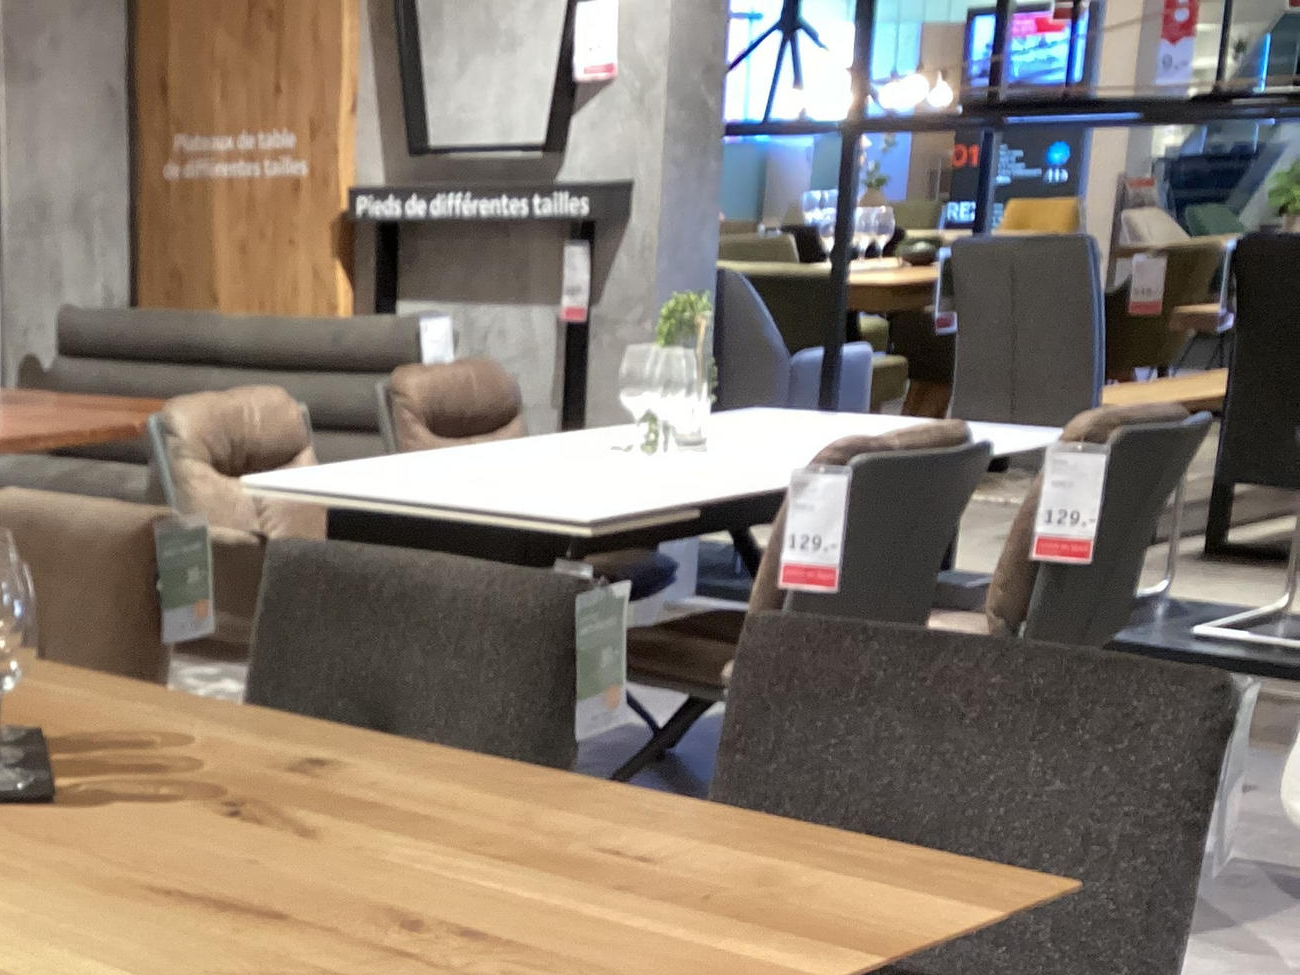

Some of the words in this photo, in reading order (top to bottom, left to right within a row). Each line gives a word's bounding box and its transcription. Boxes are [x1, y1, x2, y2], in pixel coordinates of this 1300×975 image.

[236, 129, 255, 150] de
[257, 127, 298, 150] table
[162, 160, 180, 180] de
[263, 155, 308, 177] tailles
[355, 193, 400, 218] Pieds
[404, 193, 427, 217] de
[429, 191, 530, 218] différentes
[532, 191, 591, 217] tailles
[1043, 508, 1096, 527] 129.-
[788, 533, 838, 553] 129.-
